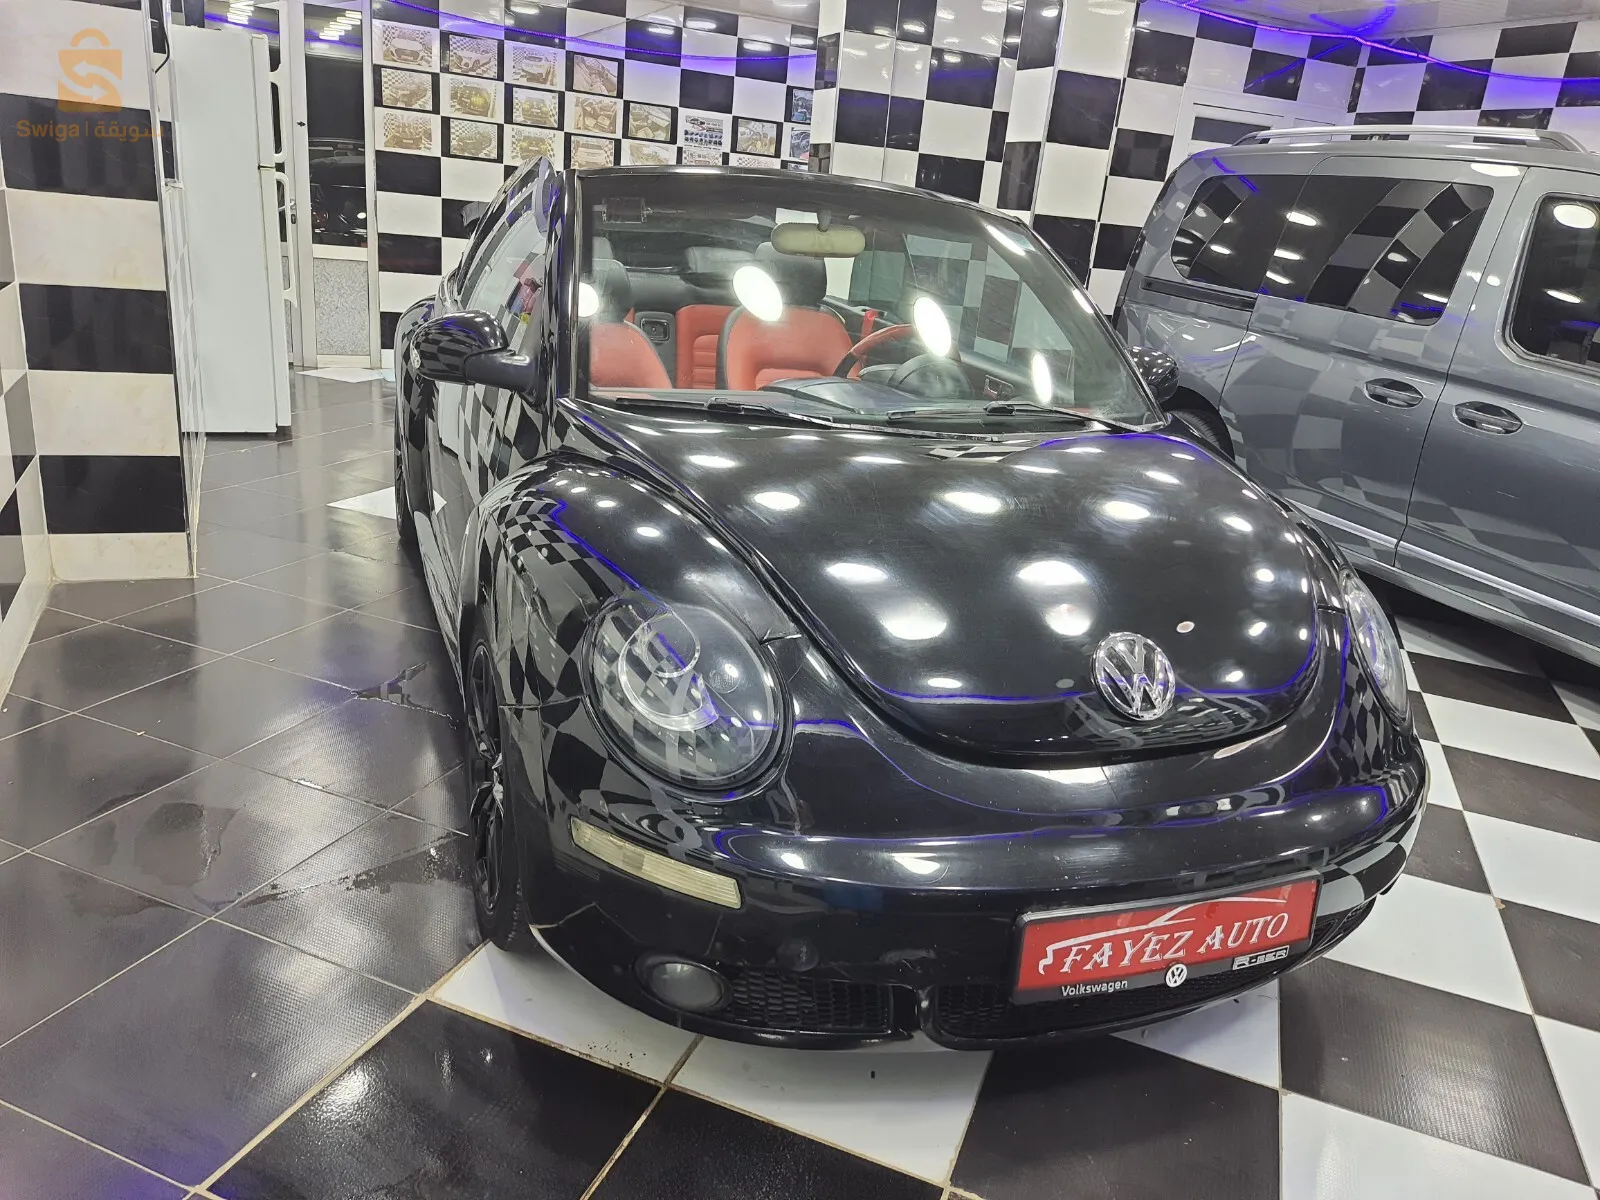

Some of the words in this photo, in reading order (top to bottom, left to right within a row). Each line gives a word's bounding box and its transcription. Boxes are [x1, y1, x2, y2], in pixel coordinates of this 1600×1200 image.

[1059, 930, 1194, 974] FAYEZ
[1197, 912, 1289, 954] AUTO
[1061, 980, 1128, 996] Volkswagen
